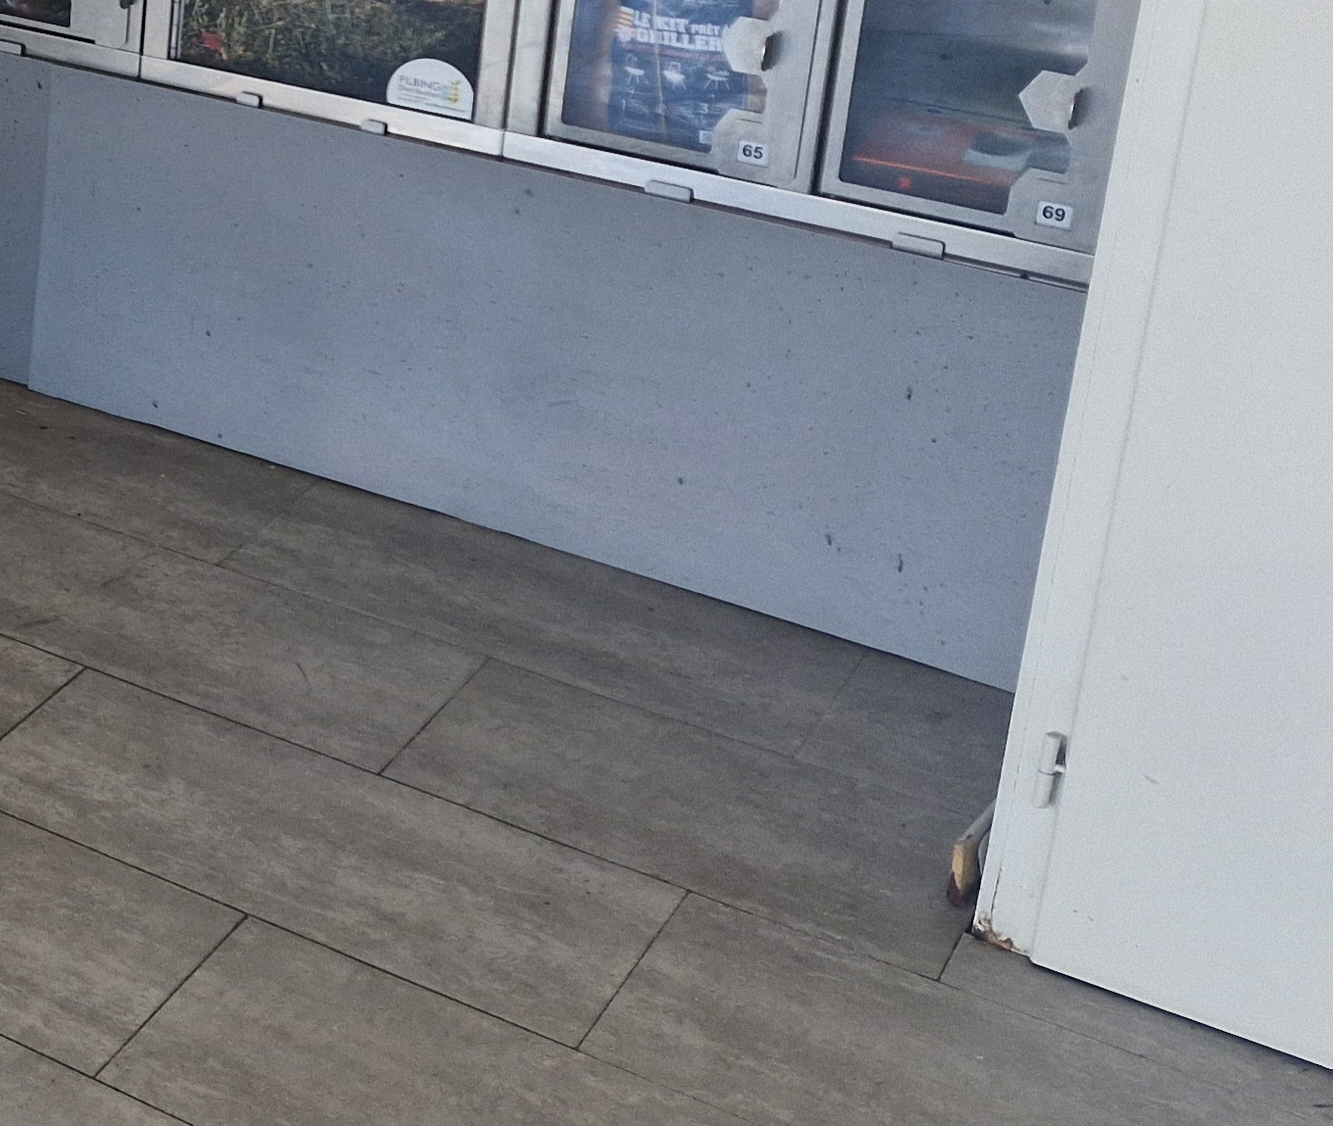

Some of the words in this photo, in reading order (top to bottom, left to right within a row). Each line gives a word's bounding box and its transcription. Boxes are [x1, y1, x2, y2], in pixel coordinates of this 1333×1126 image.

[634, 10, 650, 26] LE
[654, 16, 689, 31] KIT
[691, 24, 720, 35] PRÊT
[743, 145, 763, 159] 65
[1043, 206, 1065, 221] 69
